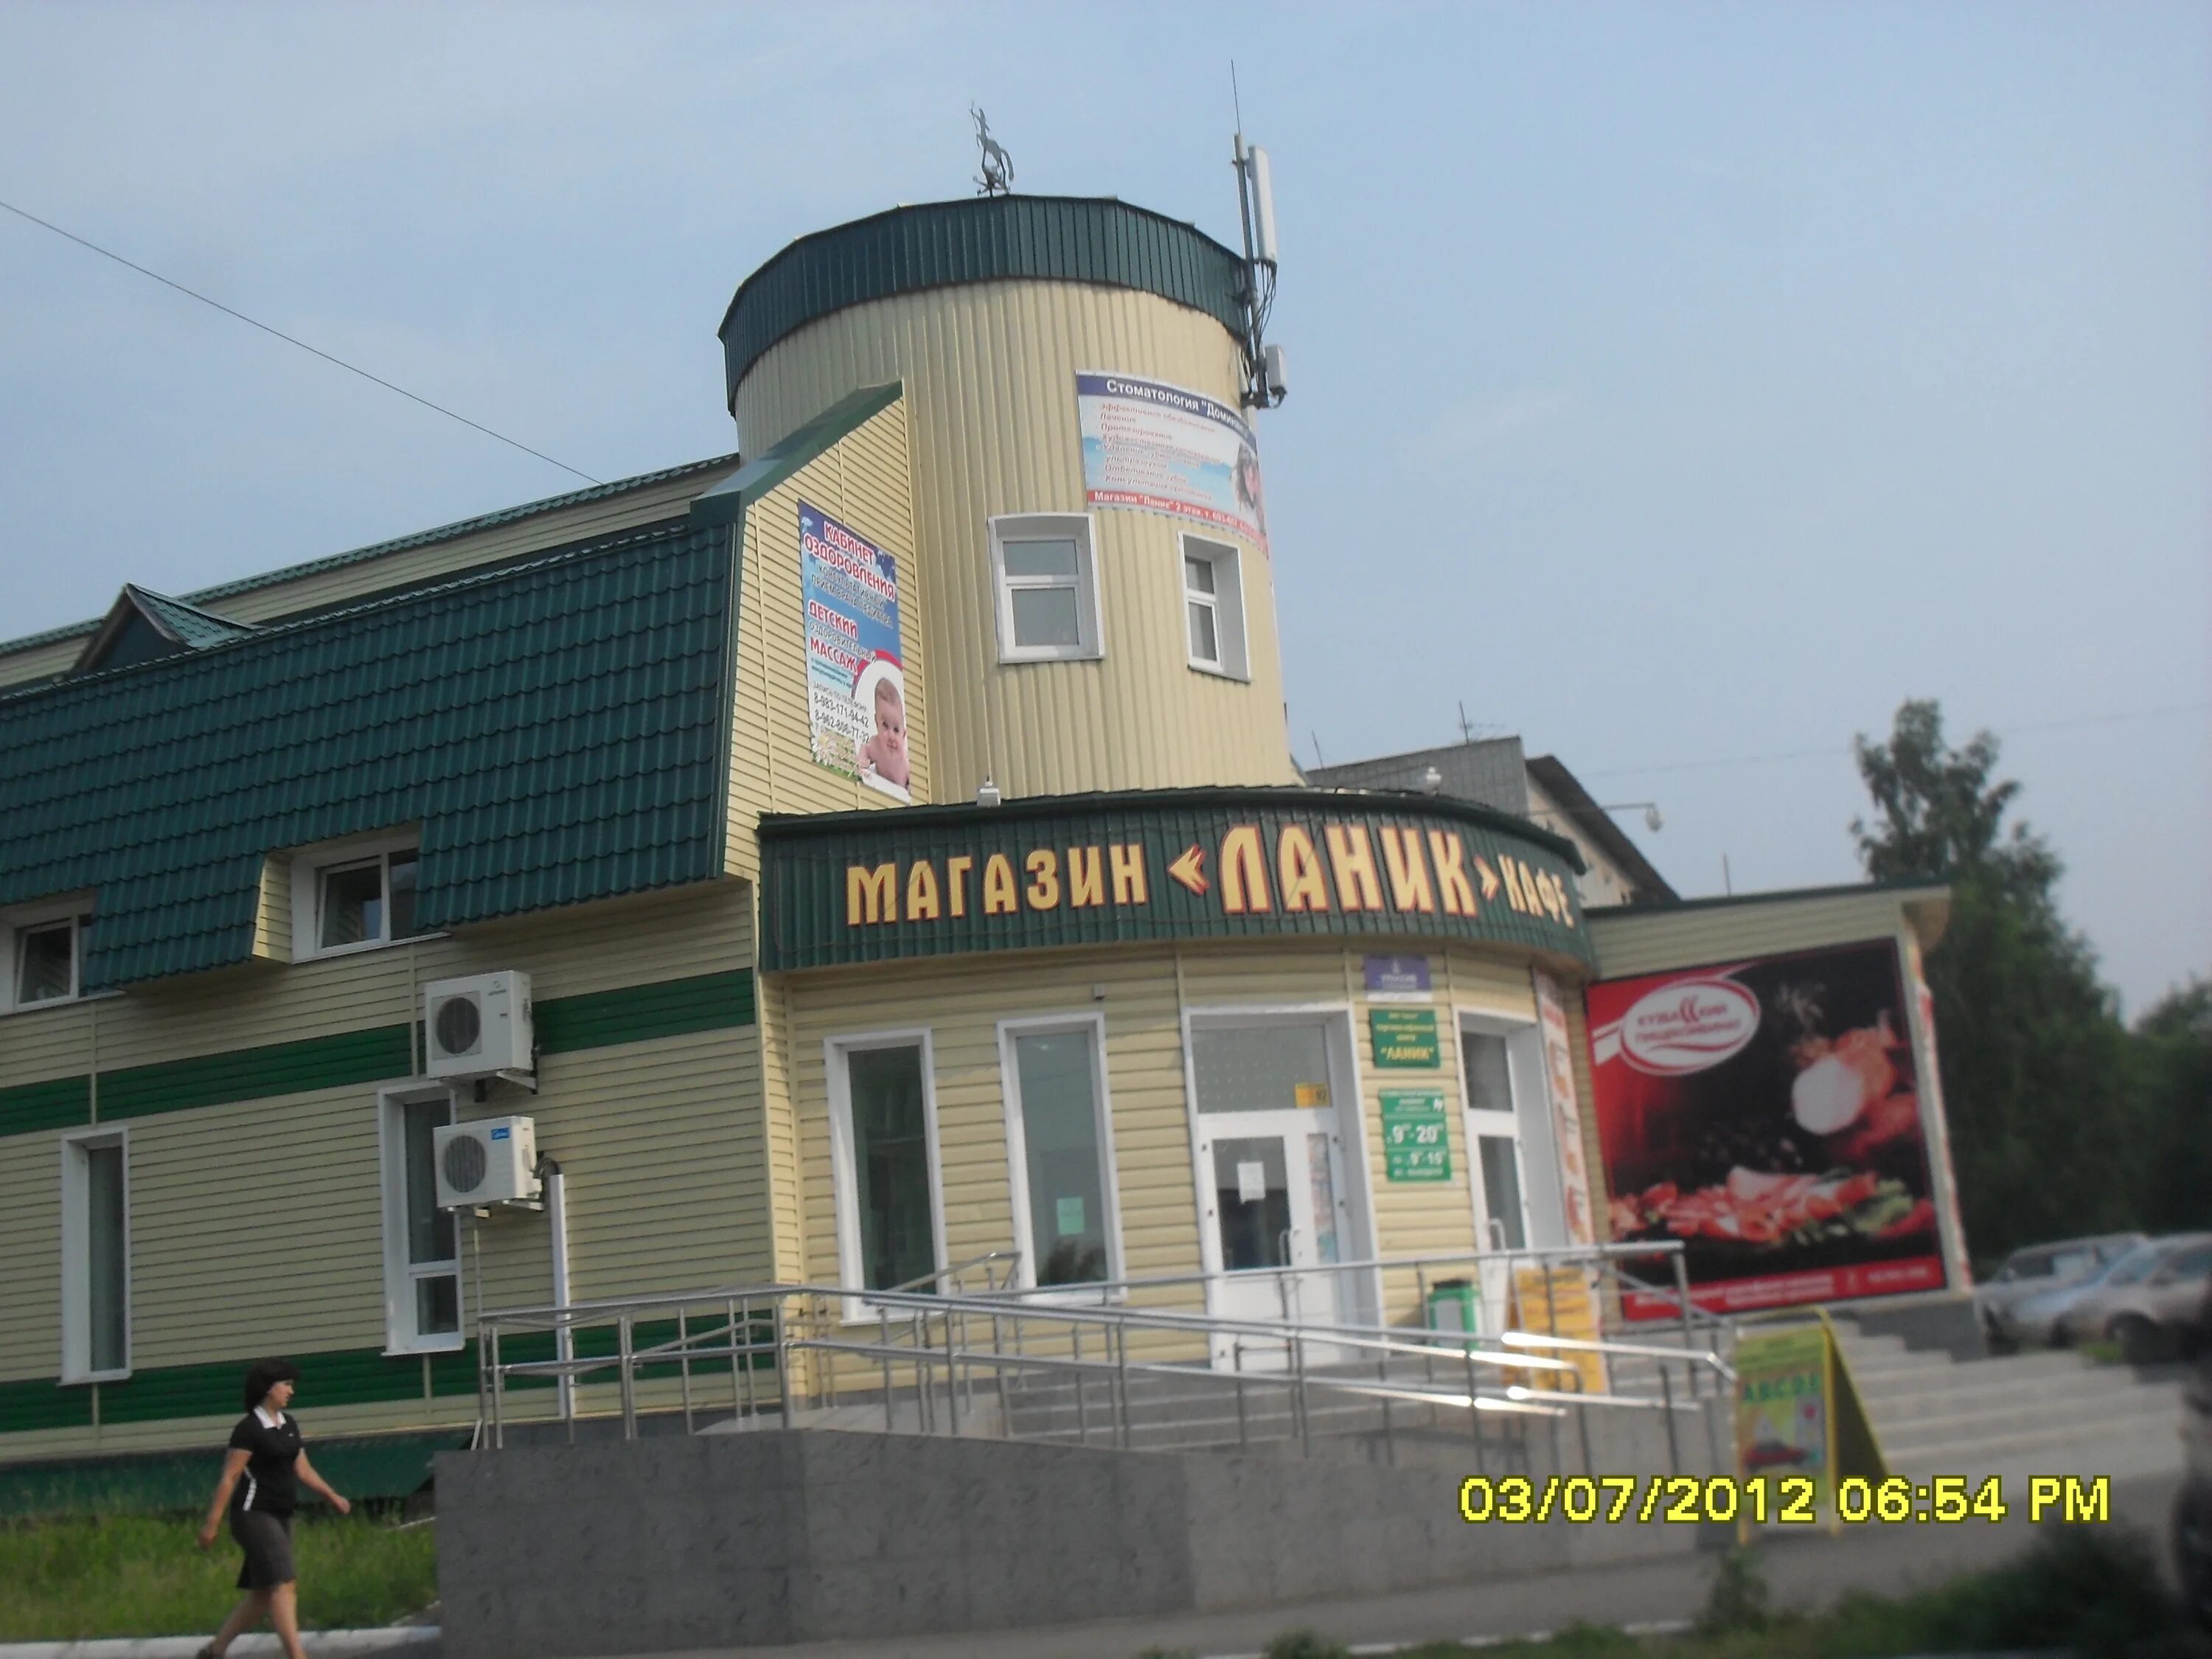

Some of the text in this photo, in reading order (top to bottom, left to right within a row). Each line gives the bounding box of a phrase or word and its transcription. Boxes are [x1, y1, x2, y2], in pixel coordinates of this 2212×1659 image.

[1106, 378, 1200, 411] Стоматология
[1094, 491, 1138, 503] Магазин
[824, 521, 875, 566] КАБИНЕТ
[804, 533, 896, 602] ОЗДОРОВЛЕНИЯ
[808, 599, 858, 640] ДЕТСКИЙ
[809, 620, 876, 663] ОЗДОРОВИТЕЛЬНЫЙ
[810, 636, 858, 676] МАССАЖ
[847, 844, 1147, 925] МАГАЗИН
[1498, 854, 1574, 929] КАФЕ
